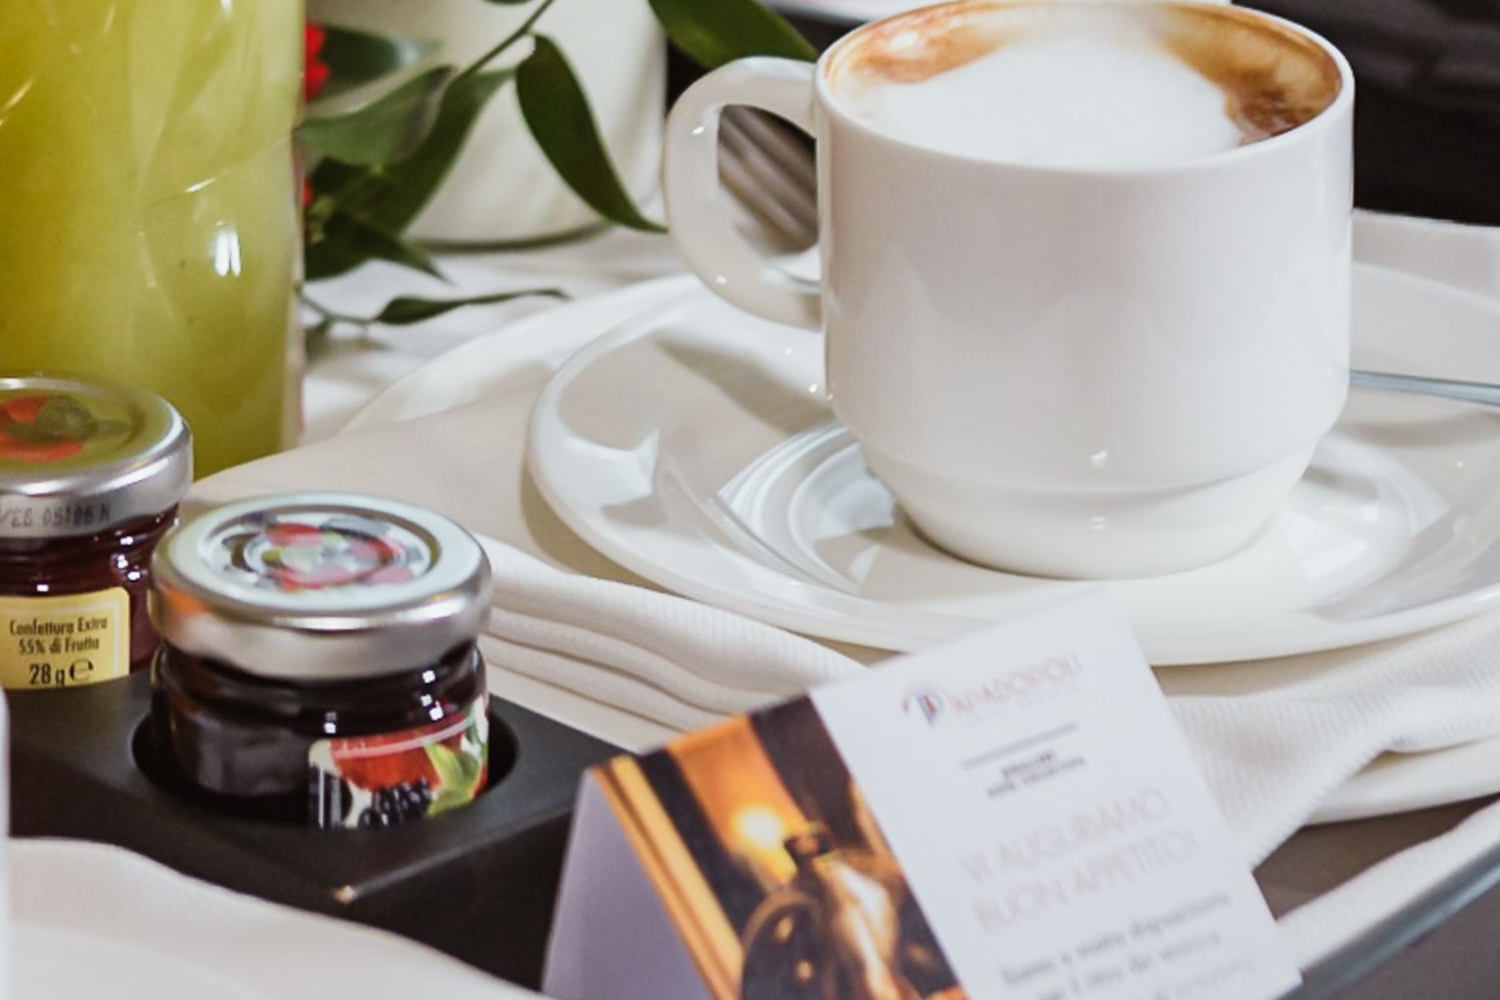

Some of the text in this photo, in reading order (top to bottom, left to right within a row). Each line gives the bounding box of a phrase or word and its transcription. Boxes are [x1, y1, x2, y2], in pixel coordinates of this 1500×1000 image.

[9, 617, 107, 635] Confettura Extra
[19, 636, 100, 655] 55% di Frutta
[29, 663, 52, 685] 28
[55, 669, 65, 687] g
[998, 787, 1170, 876] AUGURIAMO
[971, 876, 1068, 936] BUON
